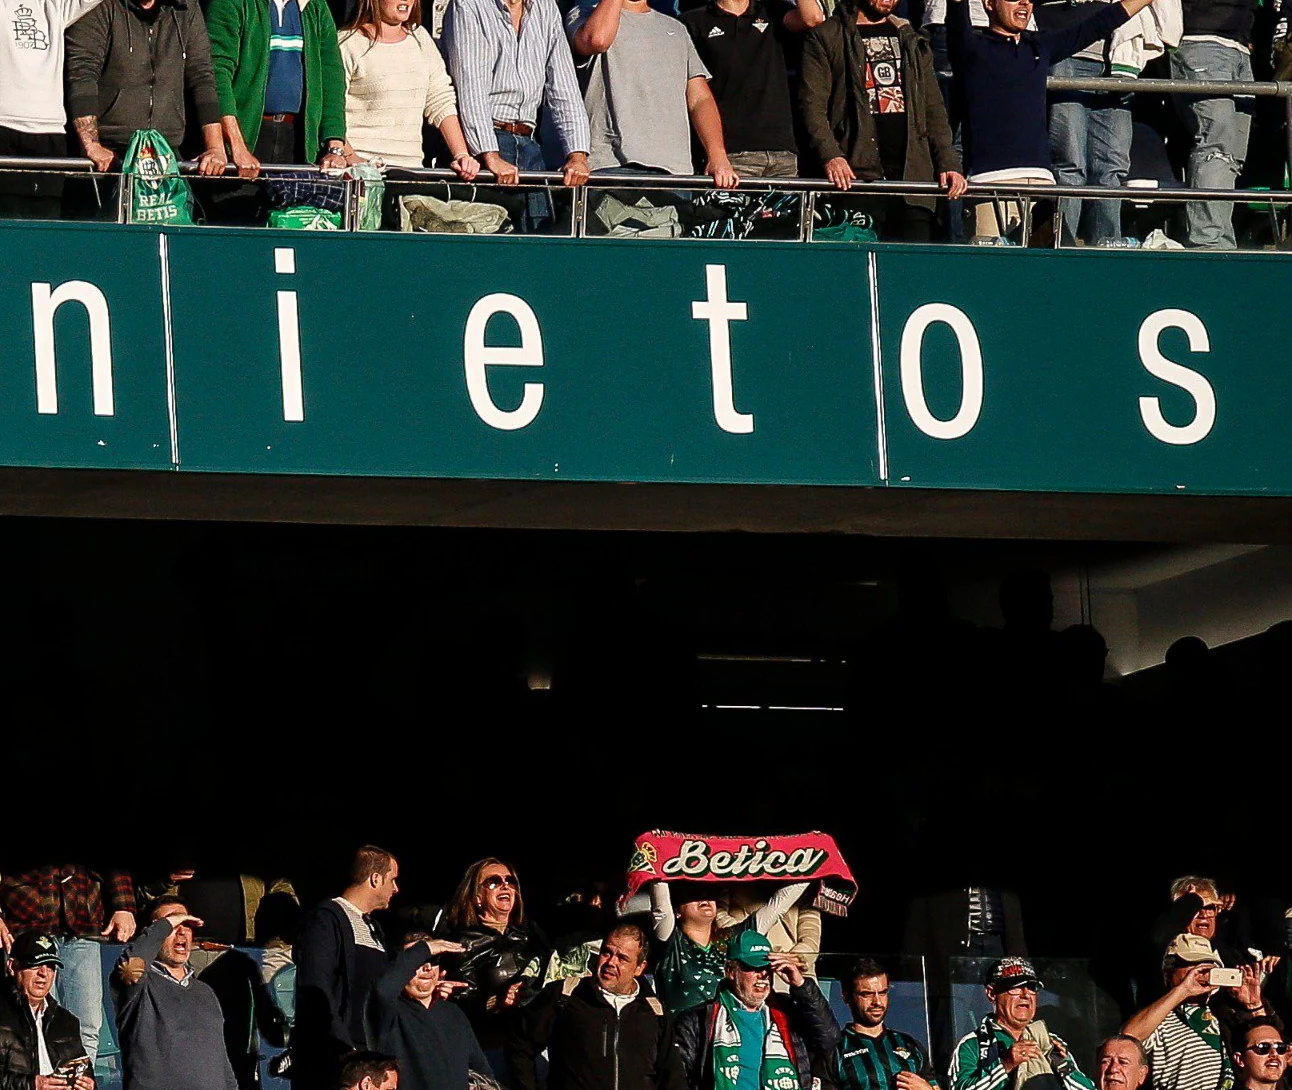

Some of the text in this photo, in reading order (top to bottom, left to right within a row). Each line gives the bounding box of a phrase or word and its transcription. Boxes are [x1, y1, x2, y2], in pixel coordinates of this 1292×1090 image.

[137, 205, 178, 221] BETIS
[138, 193, 172, 208] REAL
[32, 248, 1215, 444] nietos
[662, 840, 828, 877] Betica
